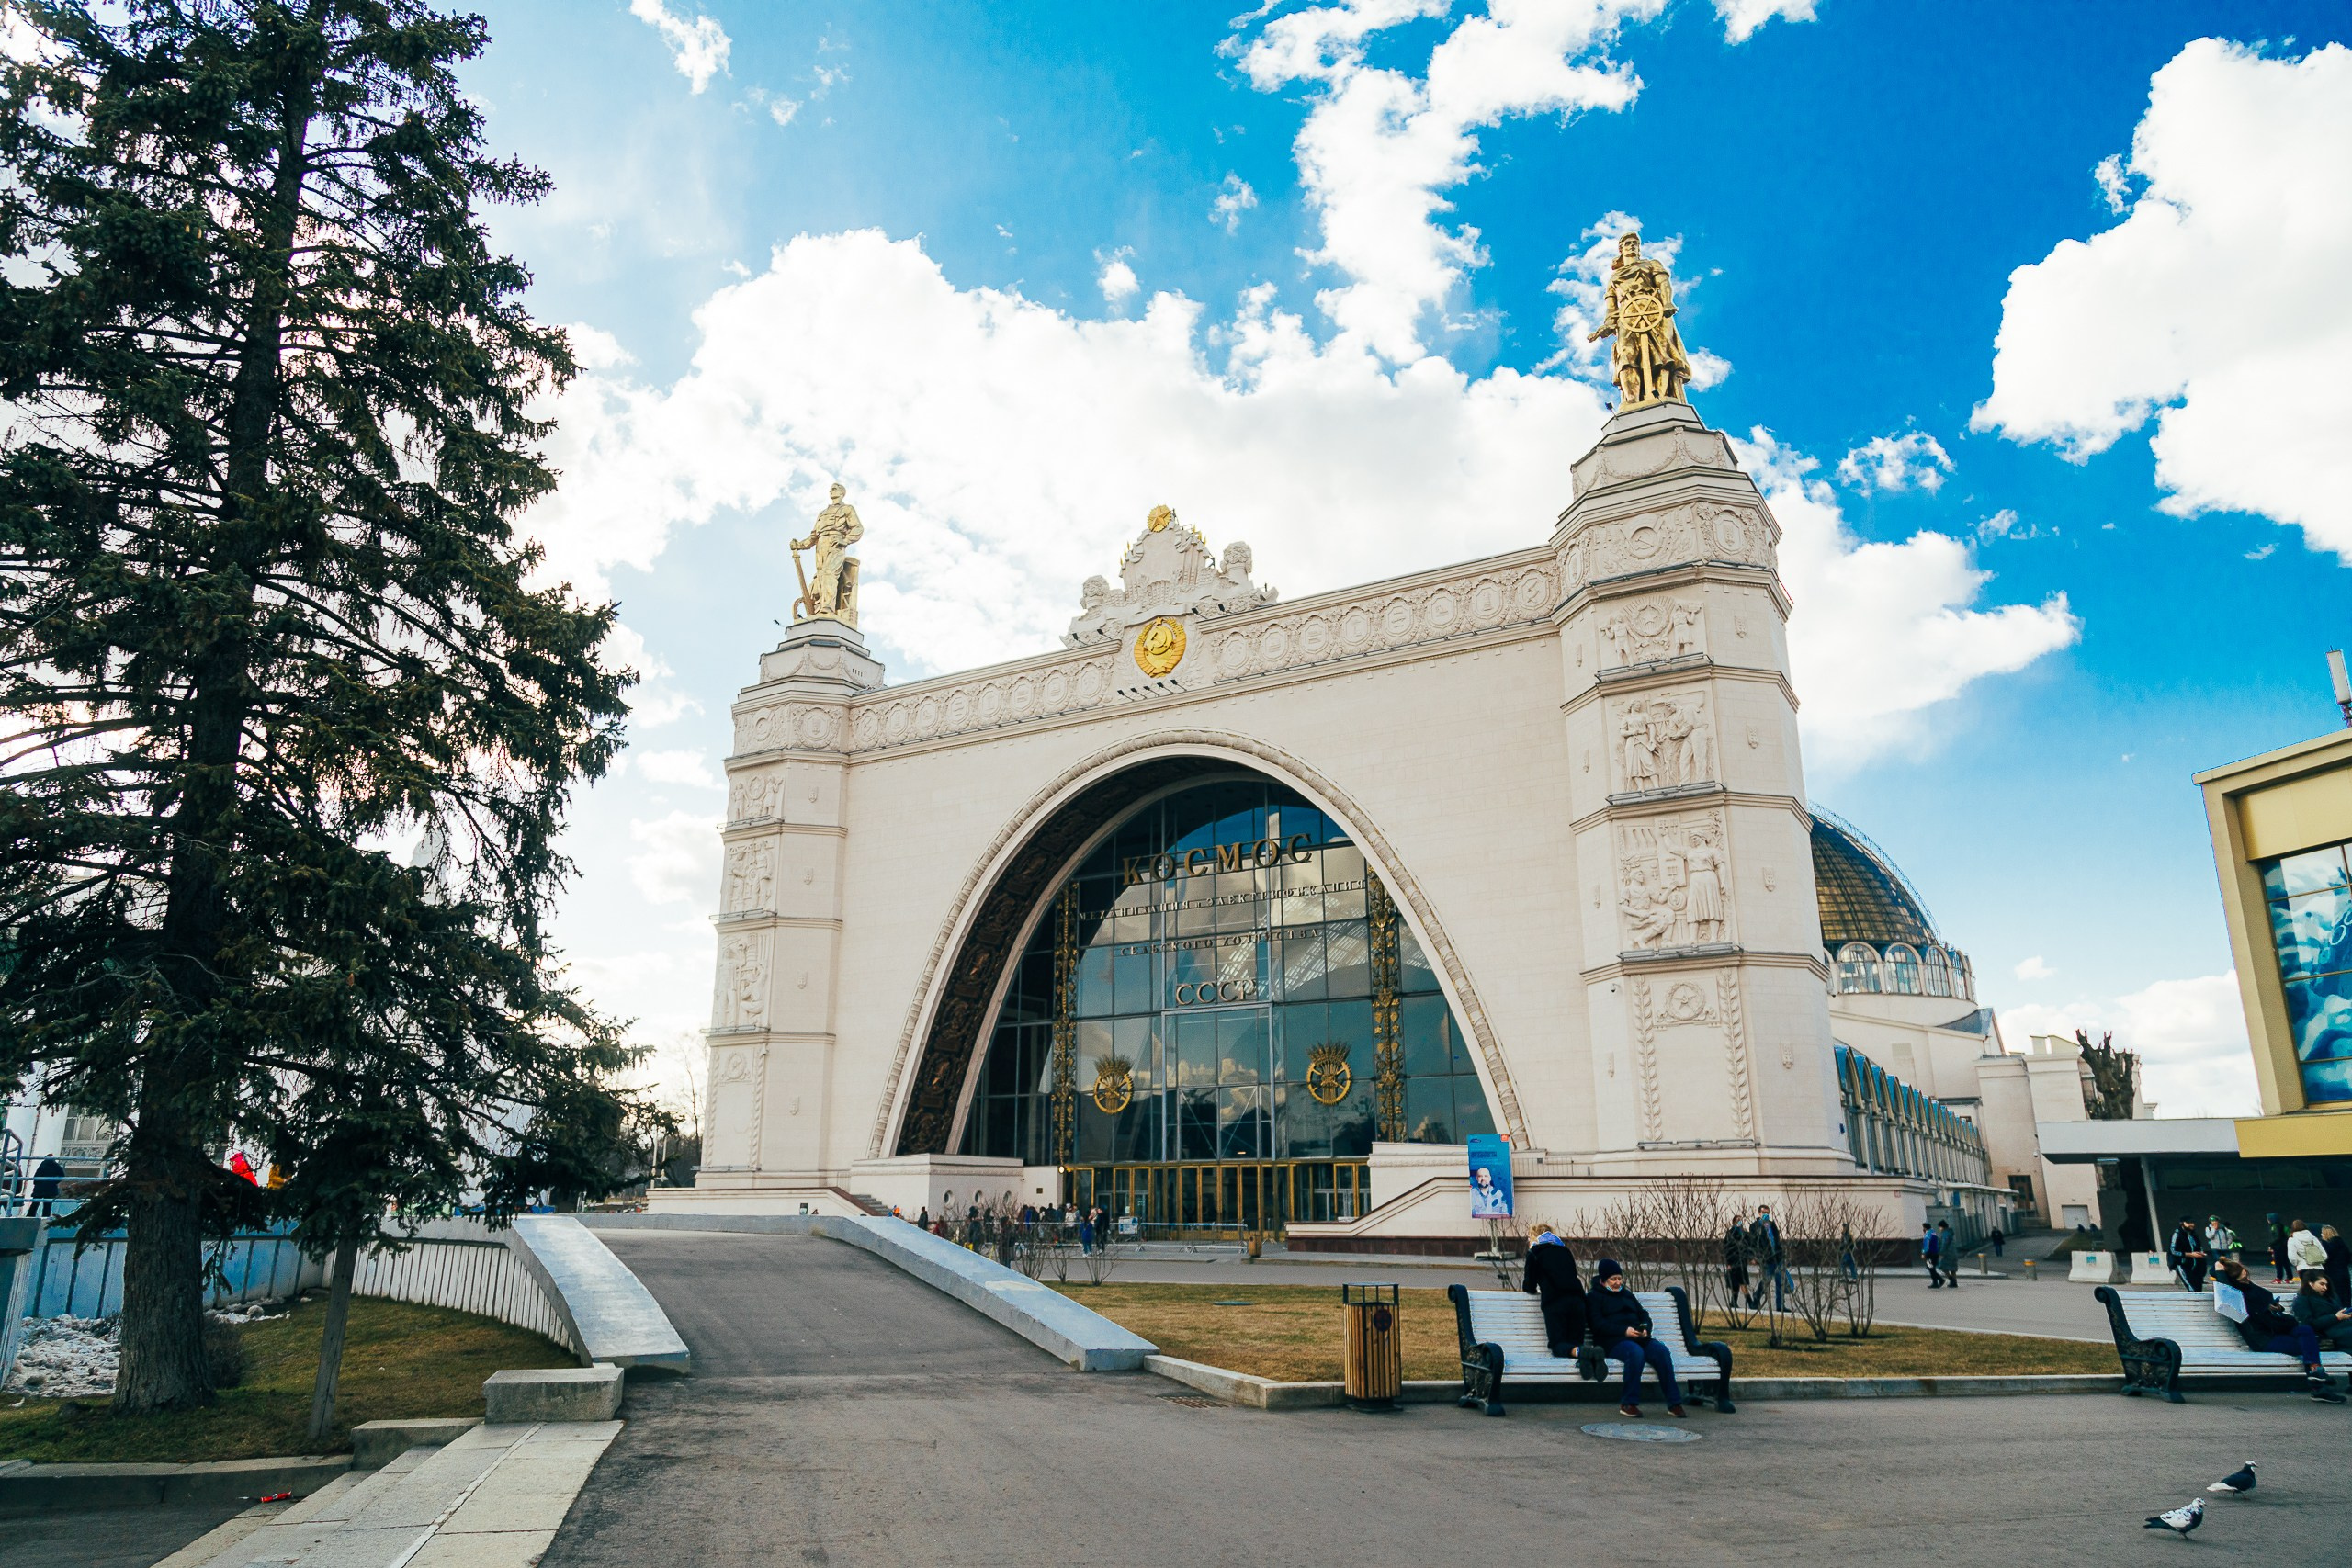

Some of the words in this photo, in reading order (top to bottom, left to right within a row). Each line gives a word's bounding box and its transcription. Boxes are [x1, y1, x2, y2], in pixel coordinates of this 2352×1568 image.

[1123, 834, 1312, 885] КОСМОС
[1079, 900, 1190, 921] МЕХАНИЗАЦИЯ
[1205, 879, 1366, 906] ЭЛЕКТРИФИКАЦИЯ
[1175, 978, 1258, 1006] СССР
